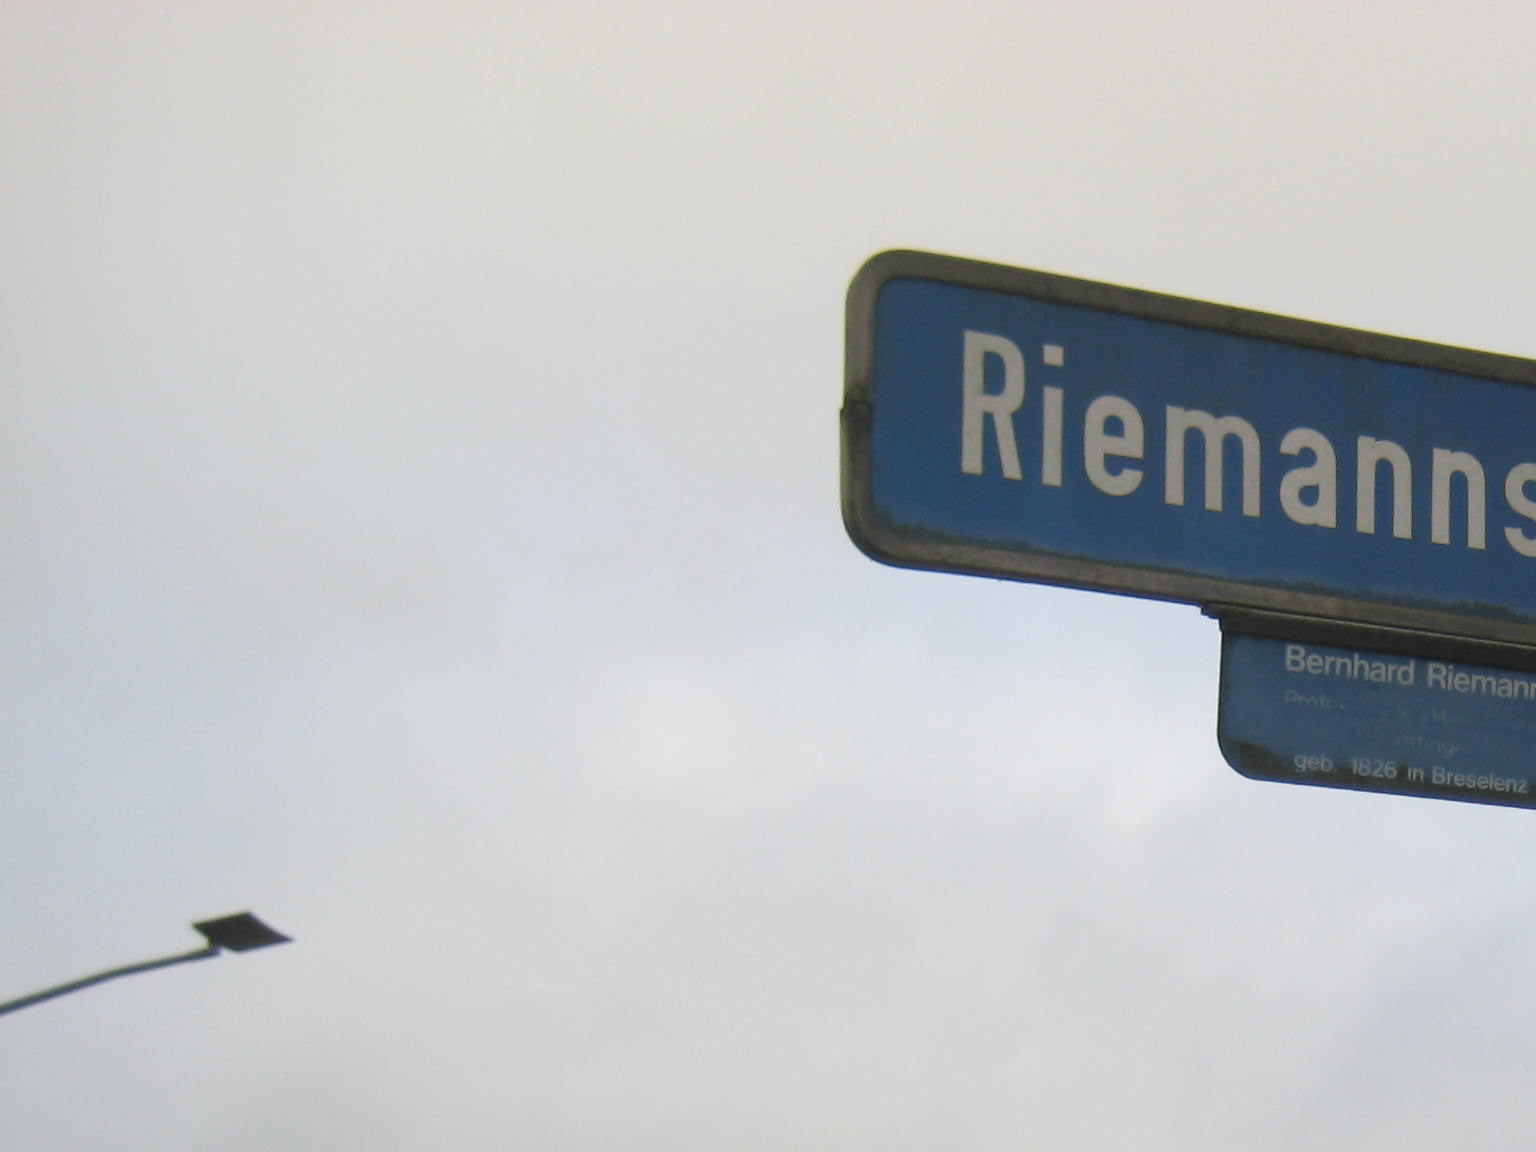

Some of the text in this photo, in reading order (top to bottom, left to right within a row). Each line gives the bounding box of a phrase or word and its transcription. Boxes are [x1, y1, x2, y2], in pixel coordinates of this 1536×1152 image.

[1285, 644, 1415, 687] Bernhard
[1351, 756, 1398, 781] 1826
[1407, 765, 1425, 783] in
[1431, 765, 1528, 794] Breselenz
